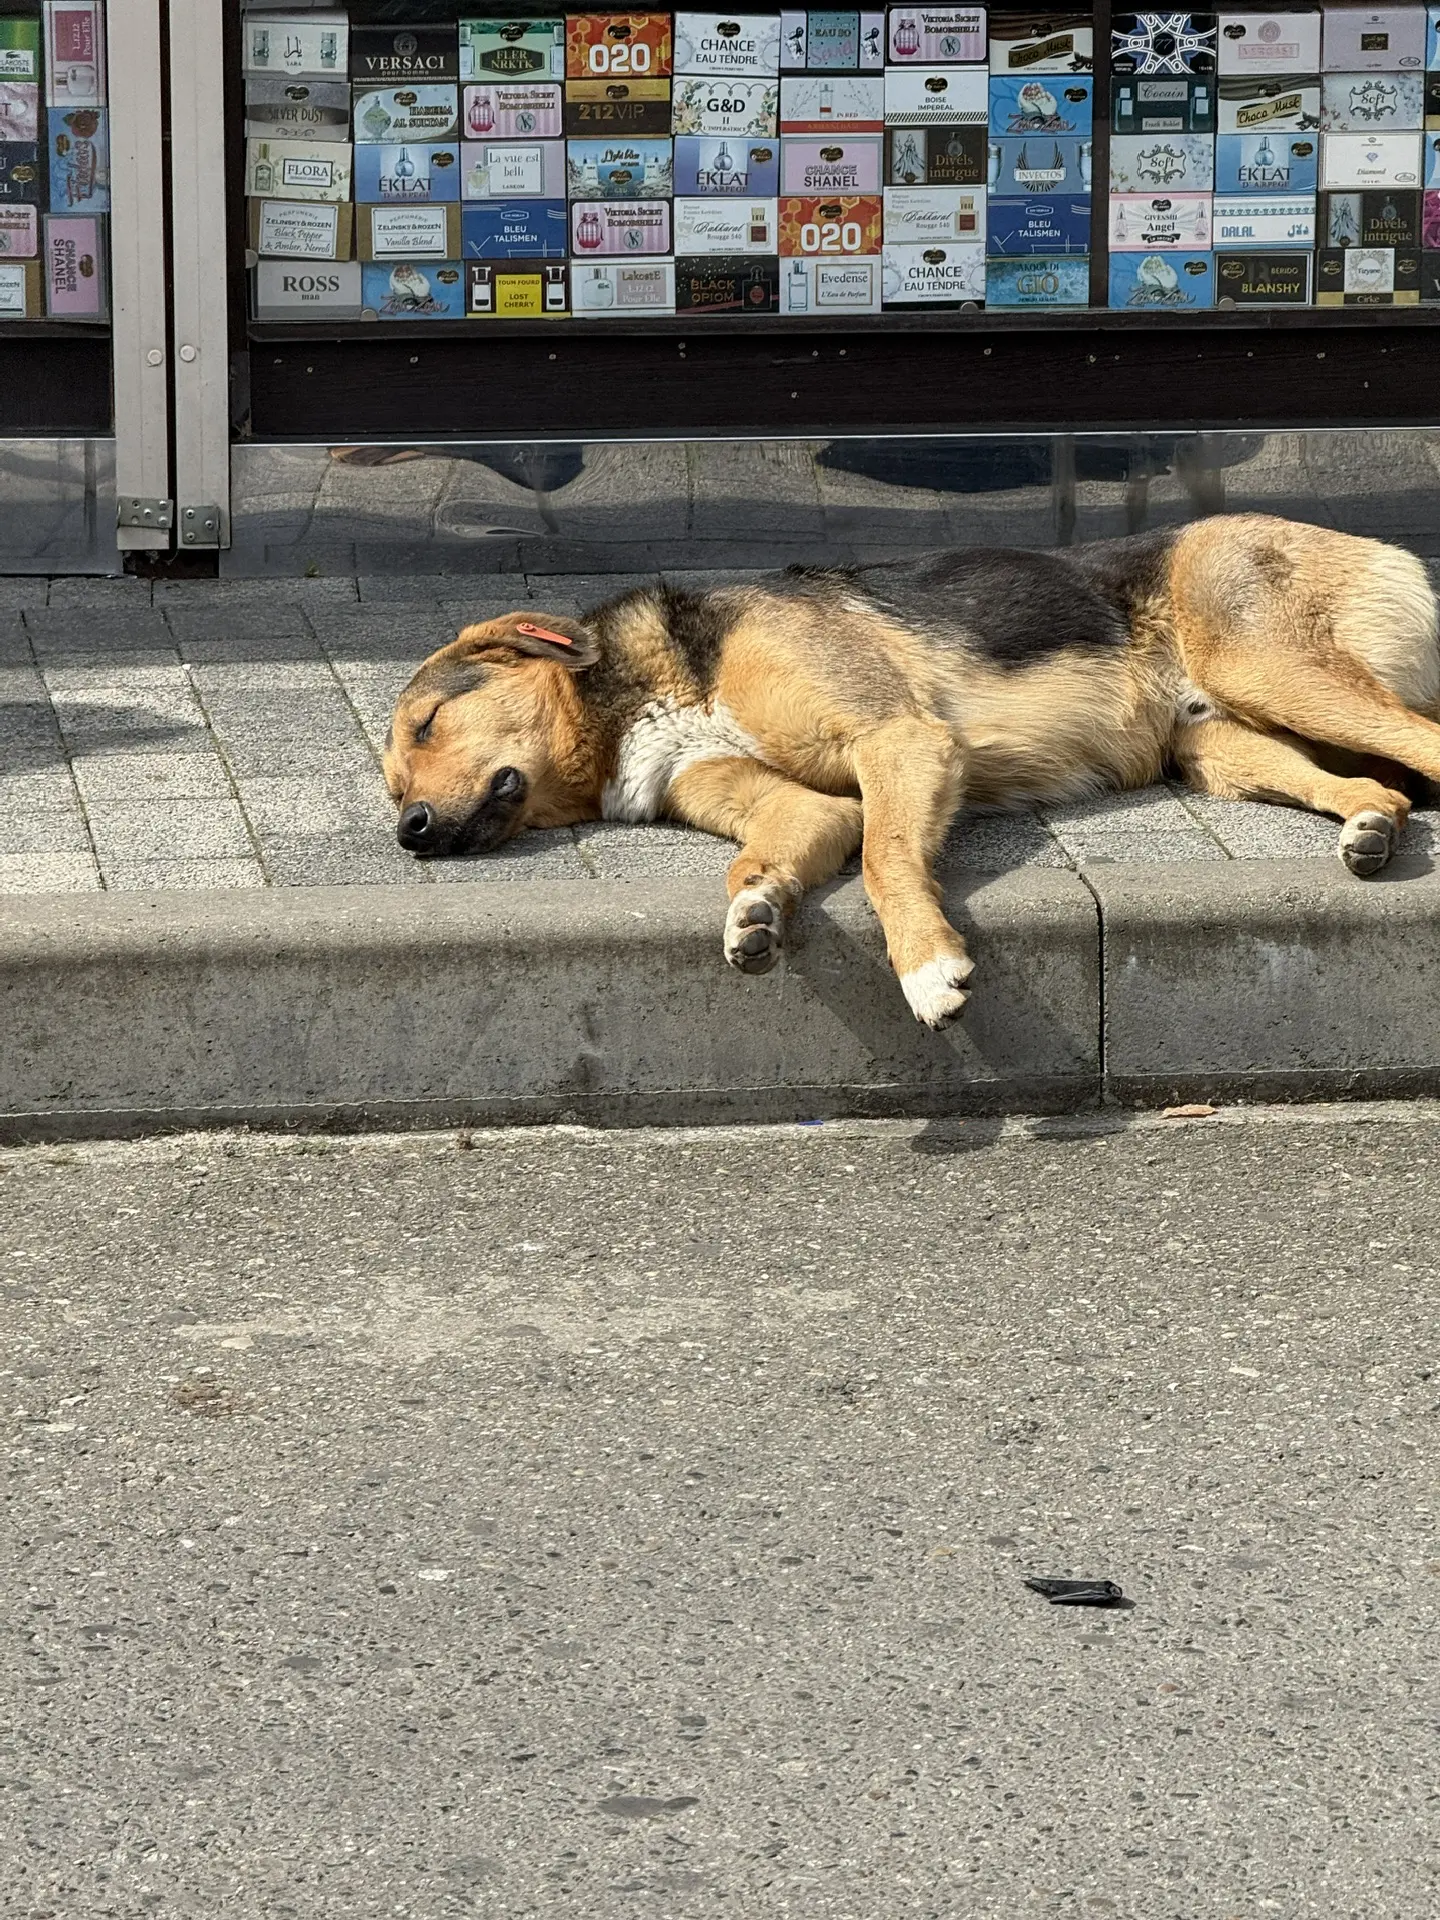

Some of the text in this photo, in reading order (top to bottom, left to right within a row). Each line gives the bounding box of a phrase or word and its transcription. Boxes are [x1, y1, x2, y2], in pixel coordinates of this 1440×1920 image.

[815, 29, 836, 37] EAU
[700, 39, 756, 53] CHANCE
[364, 55, 445, 70] VERSACI
[490, 60, 534, 70] NRKTK
[589, 44, 650, 73] 020
[695, 54, 758, 65] EAU TENDRE
[1140, 82, 1185, 99] Cocain
[706, 98, 746, 114] G&D
[925, 96, 947, 104] BOISE
[1360, 93, 1386, 109] Soft
[268, 107, 325, 123] SILVER DUST
[409, 106, 454, 116] HAREEM
[1239, 100, 1301, 124] Choco Musk
[393, 117, 449, 129] AL SULTAN
[489, 152, 501, 163] La
[935, 155, 974, 166] Divels
[1149, 156, 1175, 171] Soft
[287, 164, 329, 177] FLORA
[804, 165, 858, 175] CHANCE
[929, 167, 979, 181] intrigue
[1237, 165, 1295, 183] ÉKLAT
[1357, 168, 1387, 176] Diamond
[696, 168, 752, 186] ÉKLAT
[804, 175, 859, 188] SHANEL
[378, 177, 436, 193] ÉKLAT
[503, 225, 527, 234] BLEU
[1028, 220, 1052, 229] BLEU
[1146, 221, 1176, 235] Angel
[1370, 218, 1409, 232] Divels
[273, 228, 323, 243] Black Pepper
[799, 222, 862, 252] 020
[1018, 229, 1061, 239] TALISMEN
[1222, 225, 1256, 238] DALAL
[1363, 230, 1413, 245] intrigue
[384, 236, 434, 247] Vanilla Blend
[493, 234, 538, 243] TALISMEN
[264, 242, 273, 250] &
[54, 238, 66, 295] SHANEL
[65, 239, 77, 292] CHANCE
[1271, 267, 1299, 275] BERIDO
[820, 272, 868, 285] Evedense
[908, 266, 962, 280] CHANCE
[282, 275, 341, 292] ROSS
[690, 279, 736, 291] BLACK
[904, 280, 966, 292] EAU TENDRE
[1241, 283, 1301, 294] BLANSHY
[508, 293, 529, 301] LOST
[690, 291, 735, 304] OPIOM
[1356, 294, 1381, 304] Cirke
[503, 301, 535, 309] CHERRY
